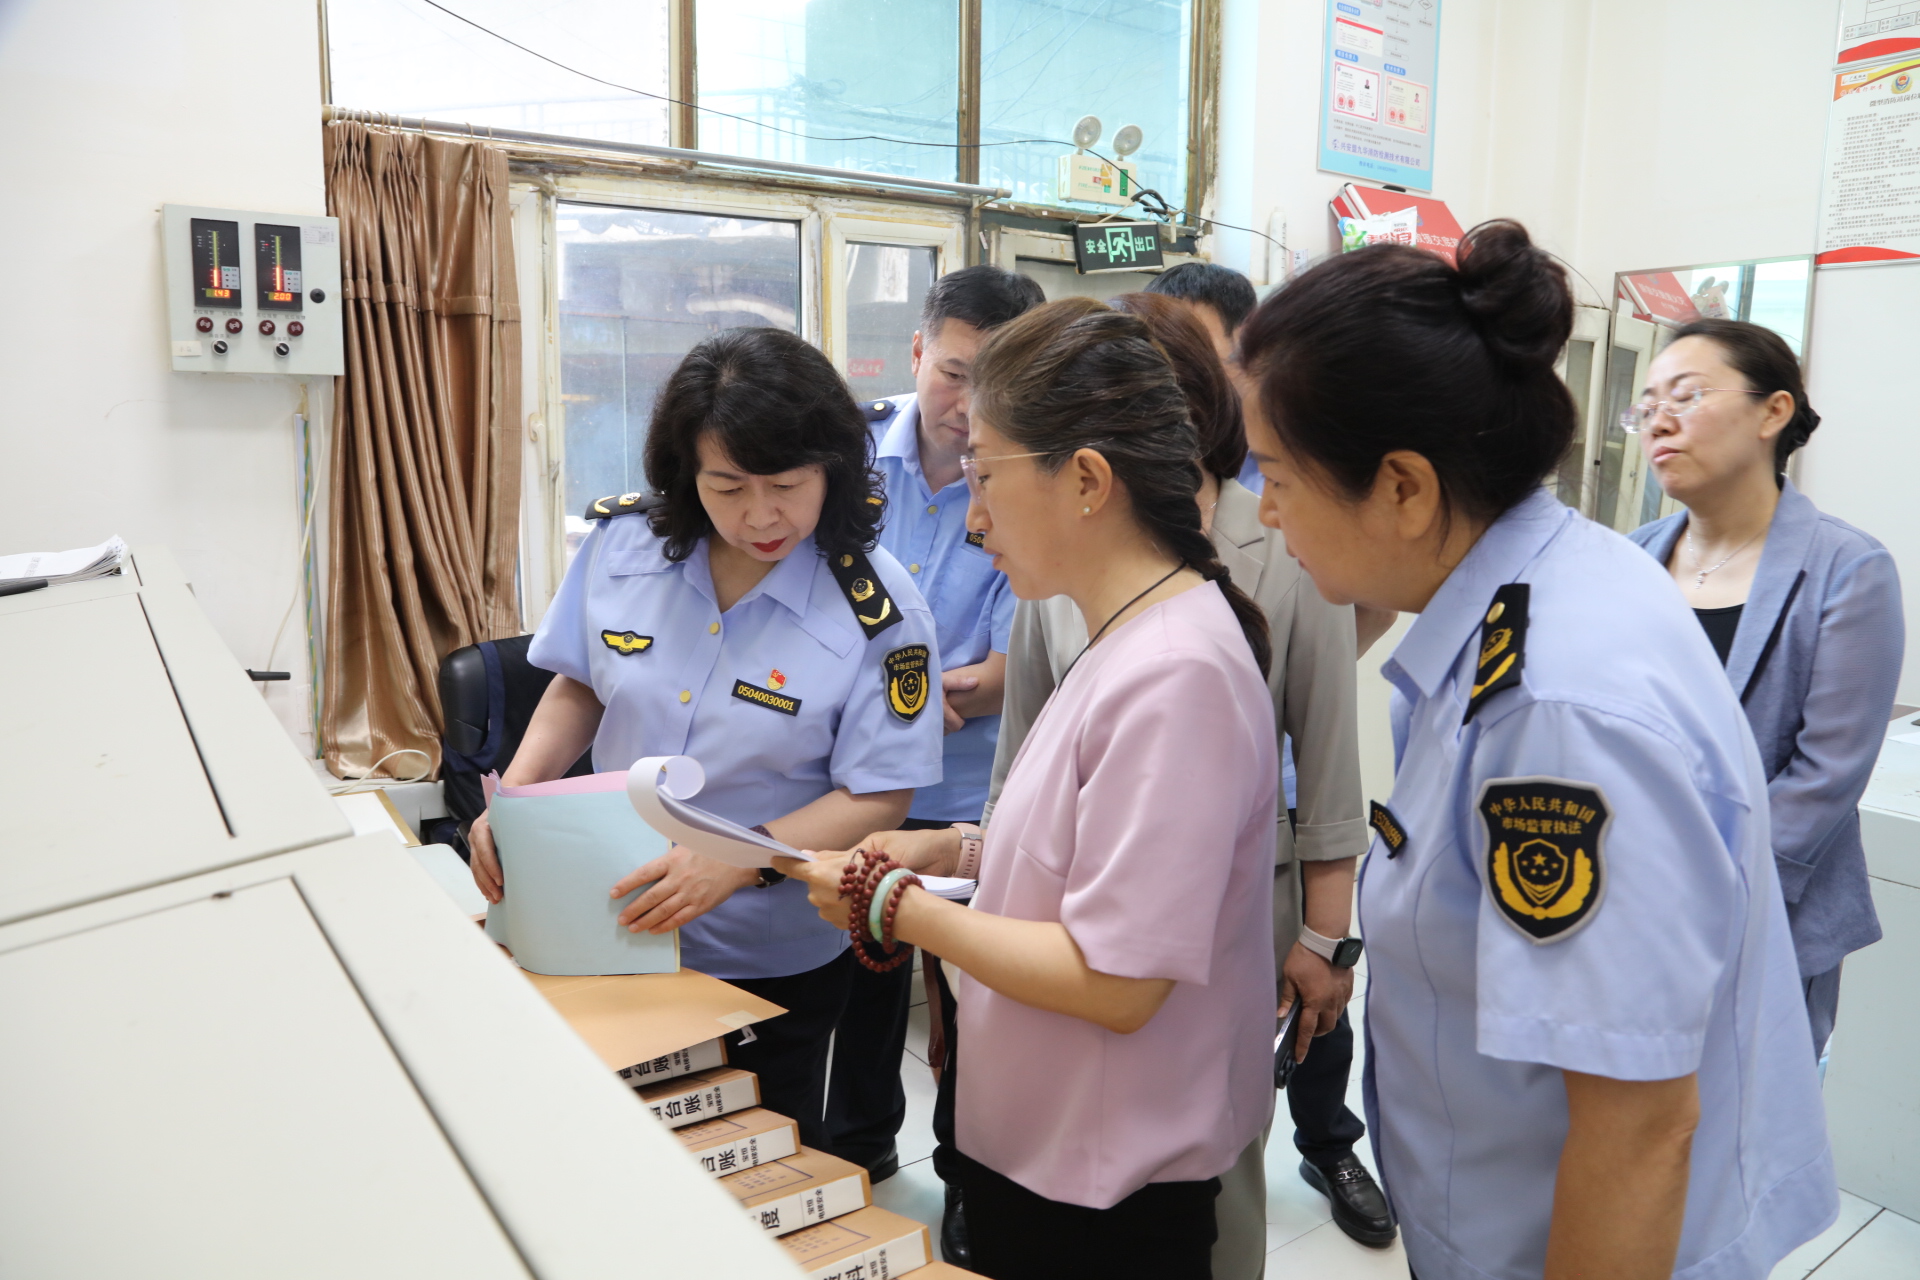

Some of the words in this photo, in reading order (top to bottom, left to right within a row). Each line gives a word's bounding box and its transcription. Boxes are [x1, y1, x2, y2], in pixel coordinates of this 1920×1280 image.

[1085, 238, 1107, 254] 安全
[1134, 235, 1155, 252] 出口
[969, 533, 985, 545] 0504
[888, 649, 927, 664] 中华人民共和国
[893, 659, 925, 671] 市场监管执法
[737, 685, 795, 711] 05040030001
[1489, 796, 1596, 823] 中华人民共和国
[1502, 817, 1582, 834] 市场监管执法
[714, 1086, 724, 1113] 电梯安全
[815, 1188, 825, 1219] 电梯安全
